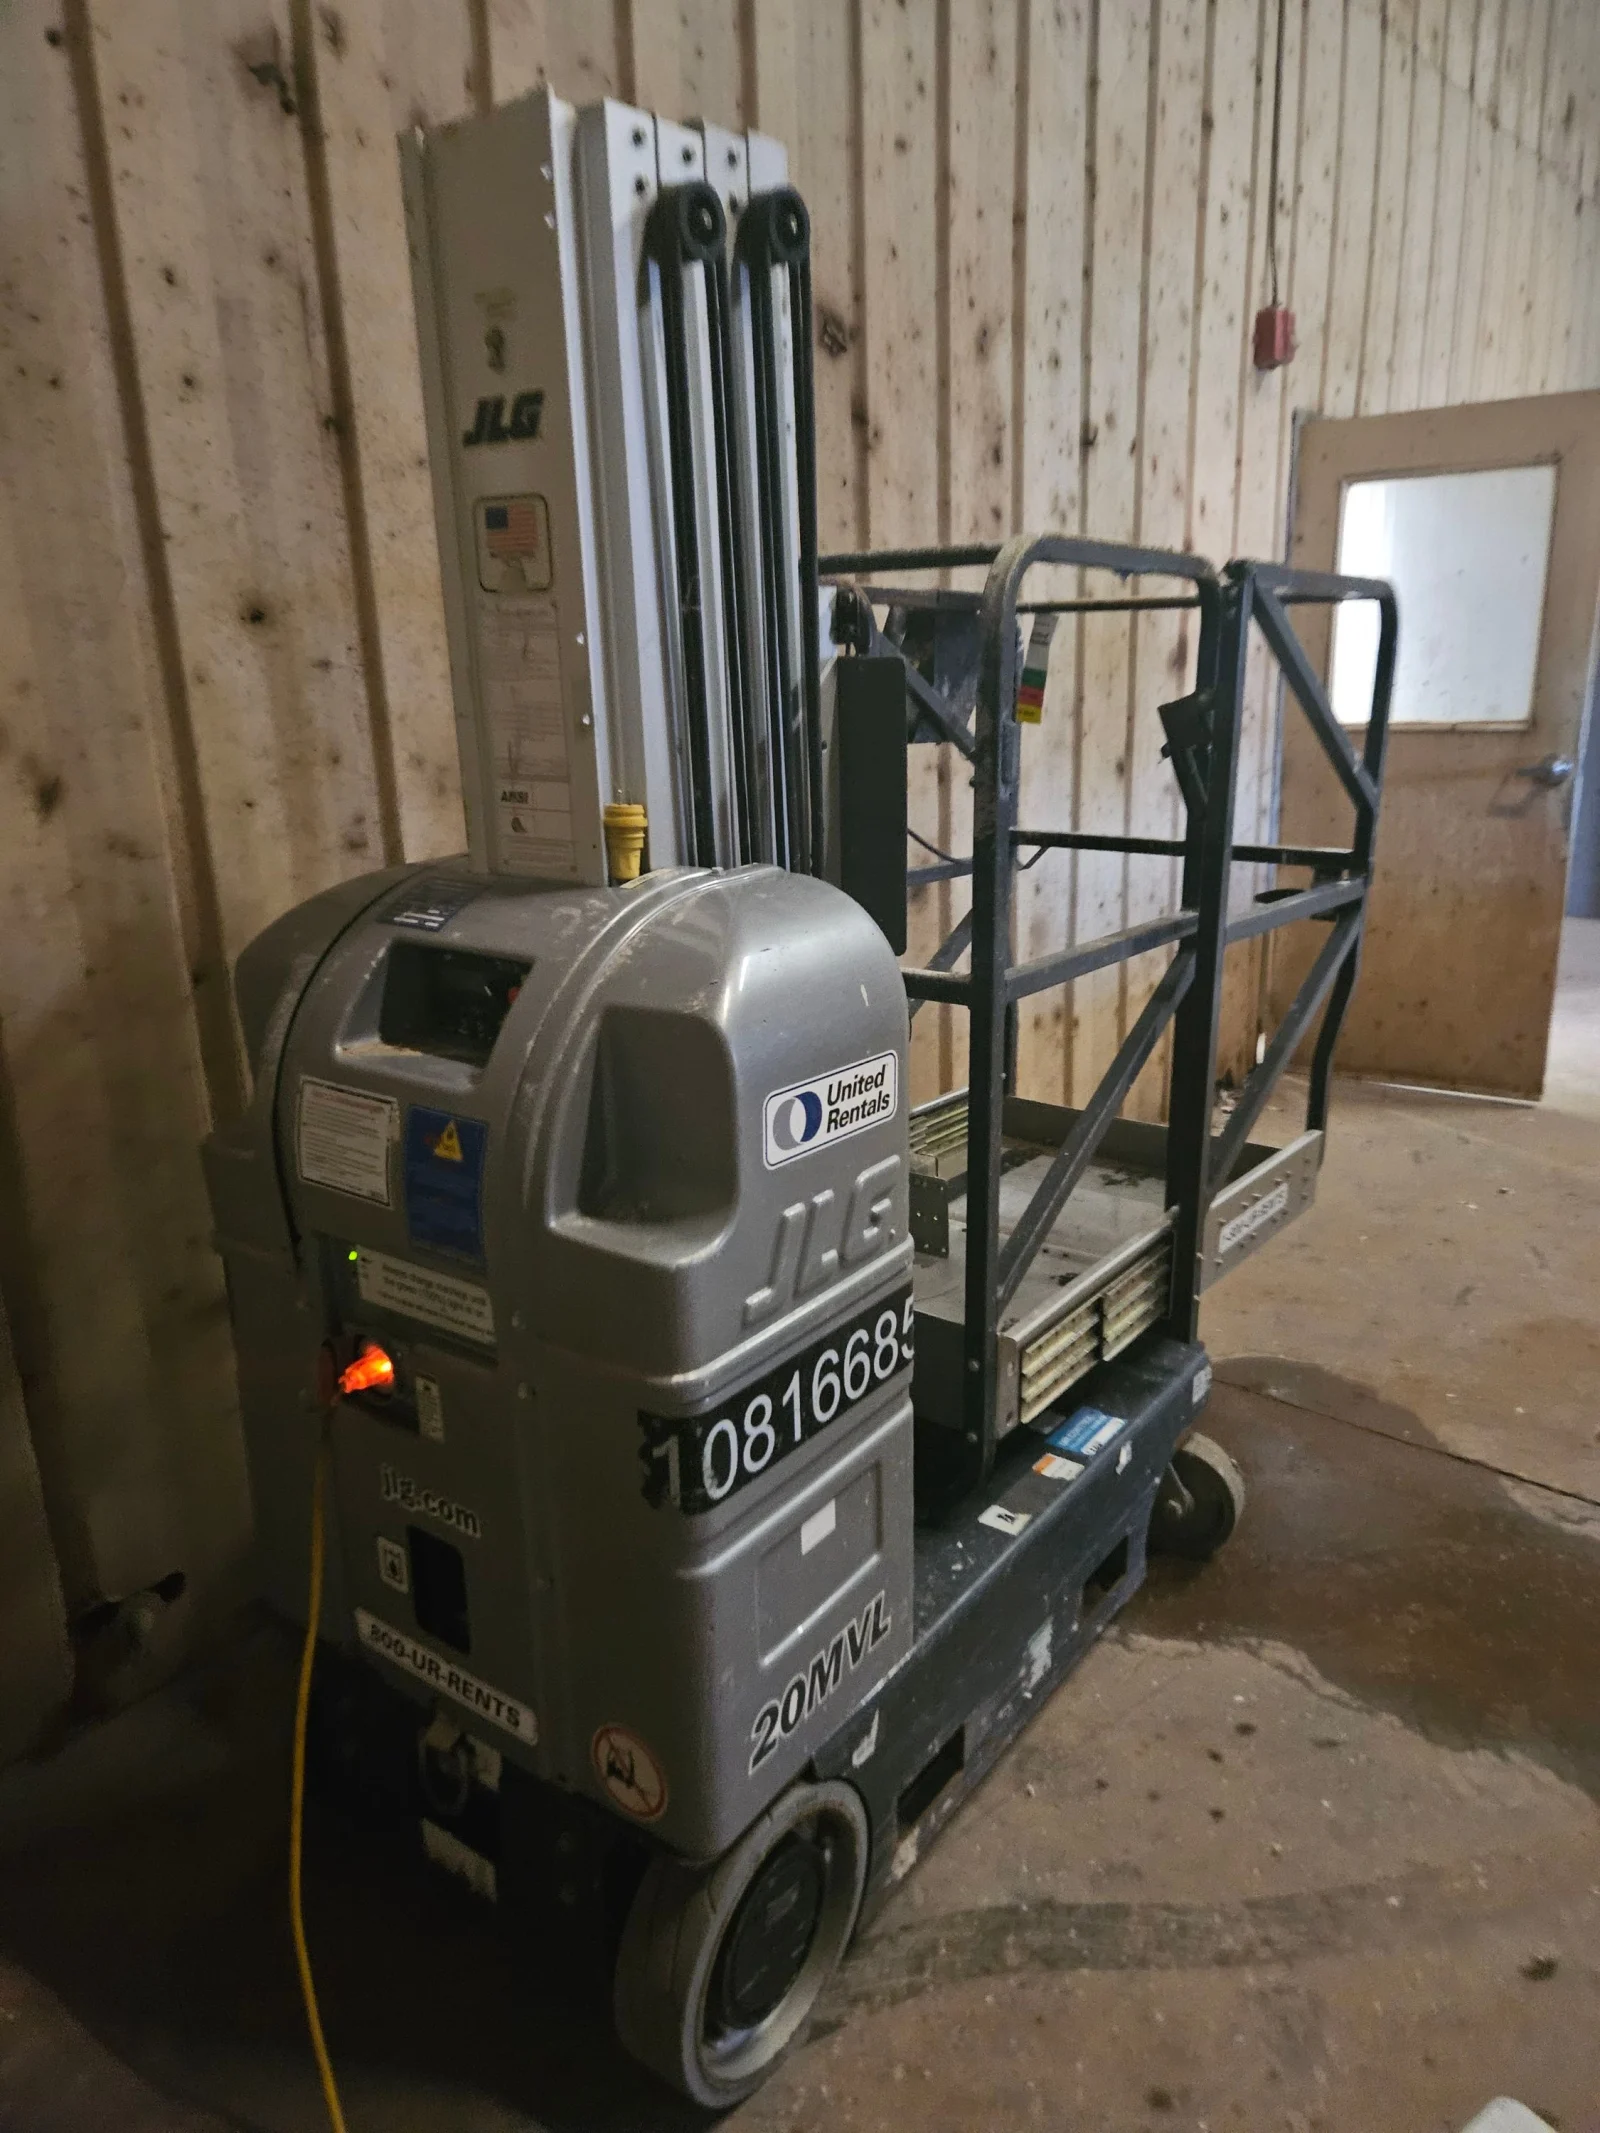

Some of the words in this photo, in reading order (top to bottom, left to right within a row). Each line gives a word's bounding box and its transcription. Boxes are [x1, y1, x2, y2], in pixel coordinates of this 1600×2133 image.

[462, 388, 544, 447] JLG
[826, 1064, 886, 1106] United
[826, 1090, 891, 1134] Rentals
[743, 1154, 901, 1325] JLG
[380, 1464, 480, 1538] jlg.com
[370, 1623, 521, 1730] 800-UR-RENTS
[749, 1590, 890, 1774] 20MVL
